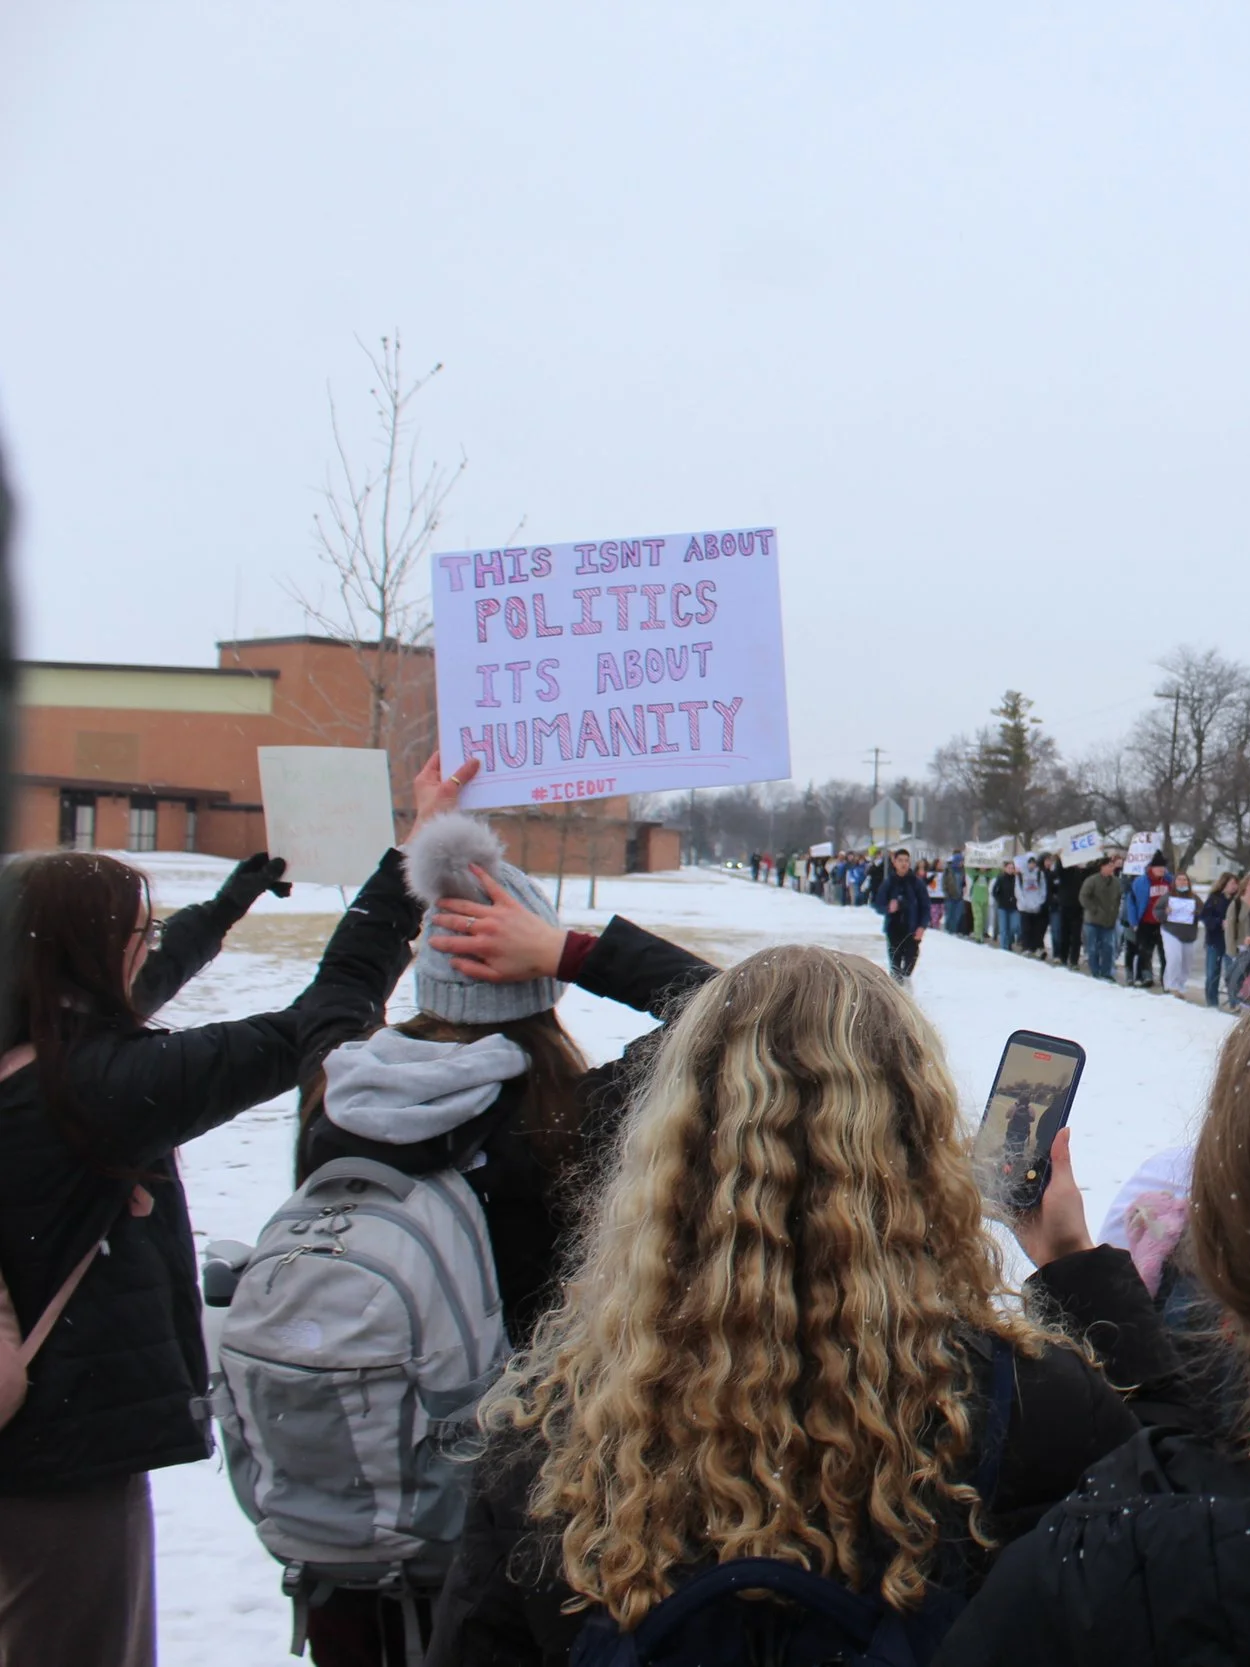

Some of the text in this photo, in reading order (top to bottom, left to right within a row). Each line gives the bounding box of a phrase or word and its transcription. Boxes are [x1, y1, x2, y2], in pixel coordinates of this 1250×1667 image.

[440, 529, 774, 592] THIS ISNT ABOUT
[476, 580, 717, 643] POLITICS
[476, 642, 713, 708] ITS ABOUT
[460, 697, 743, 772] HUMANITY
[531, 778, 617, 801] #ICEOUT
[1071, 834, 1096, 852] ICE
